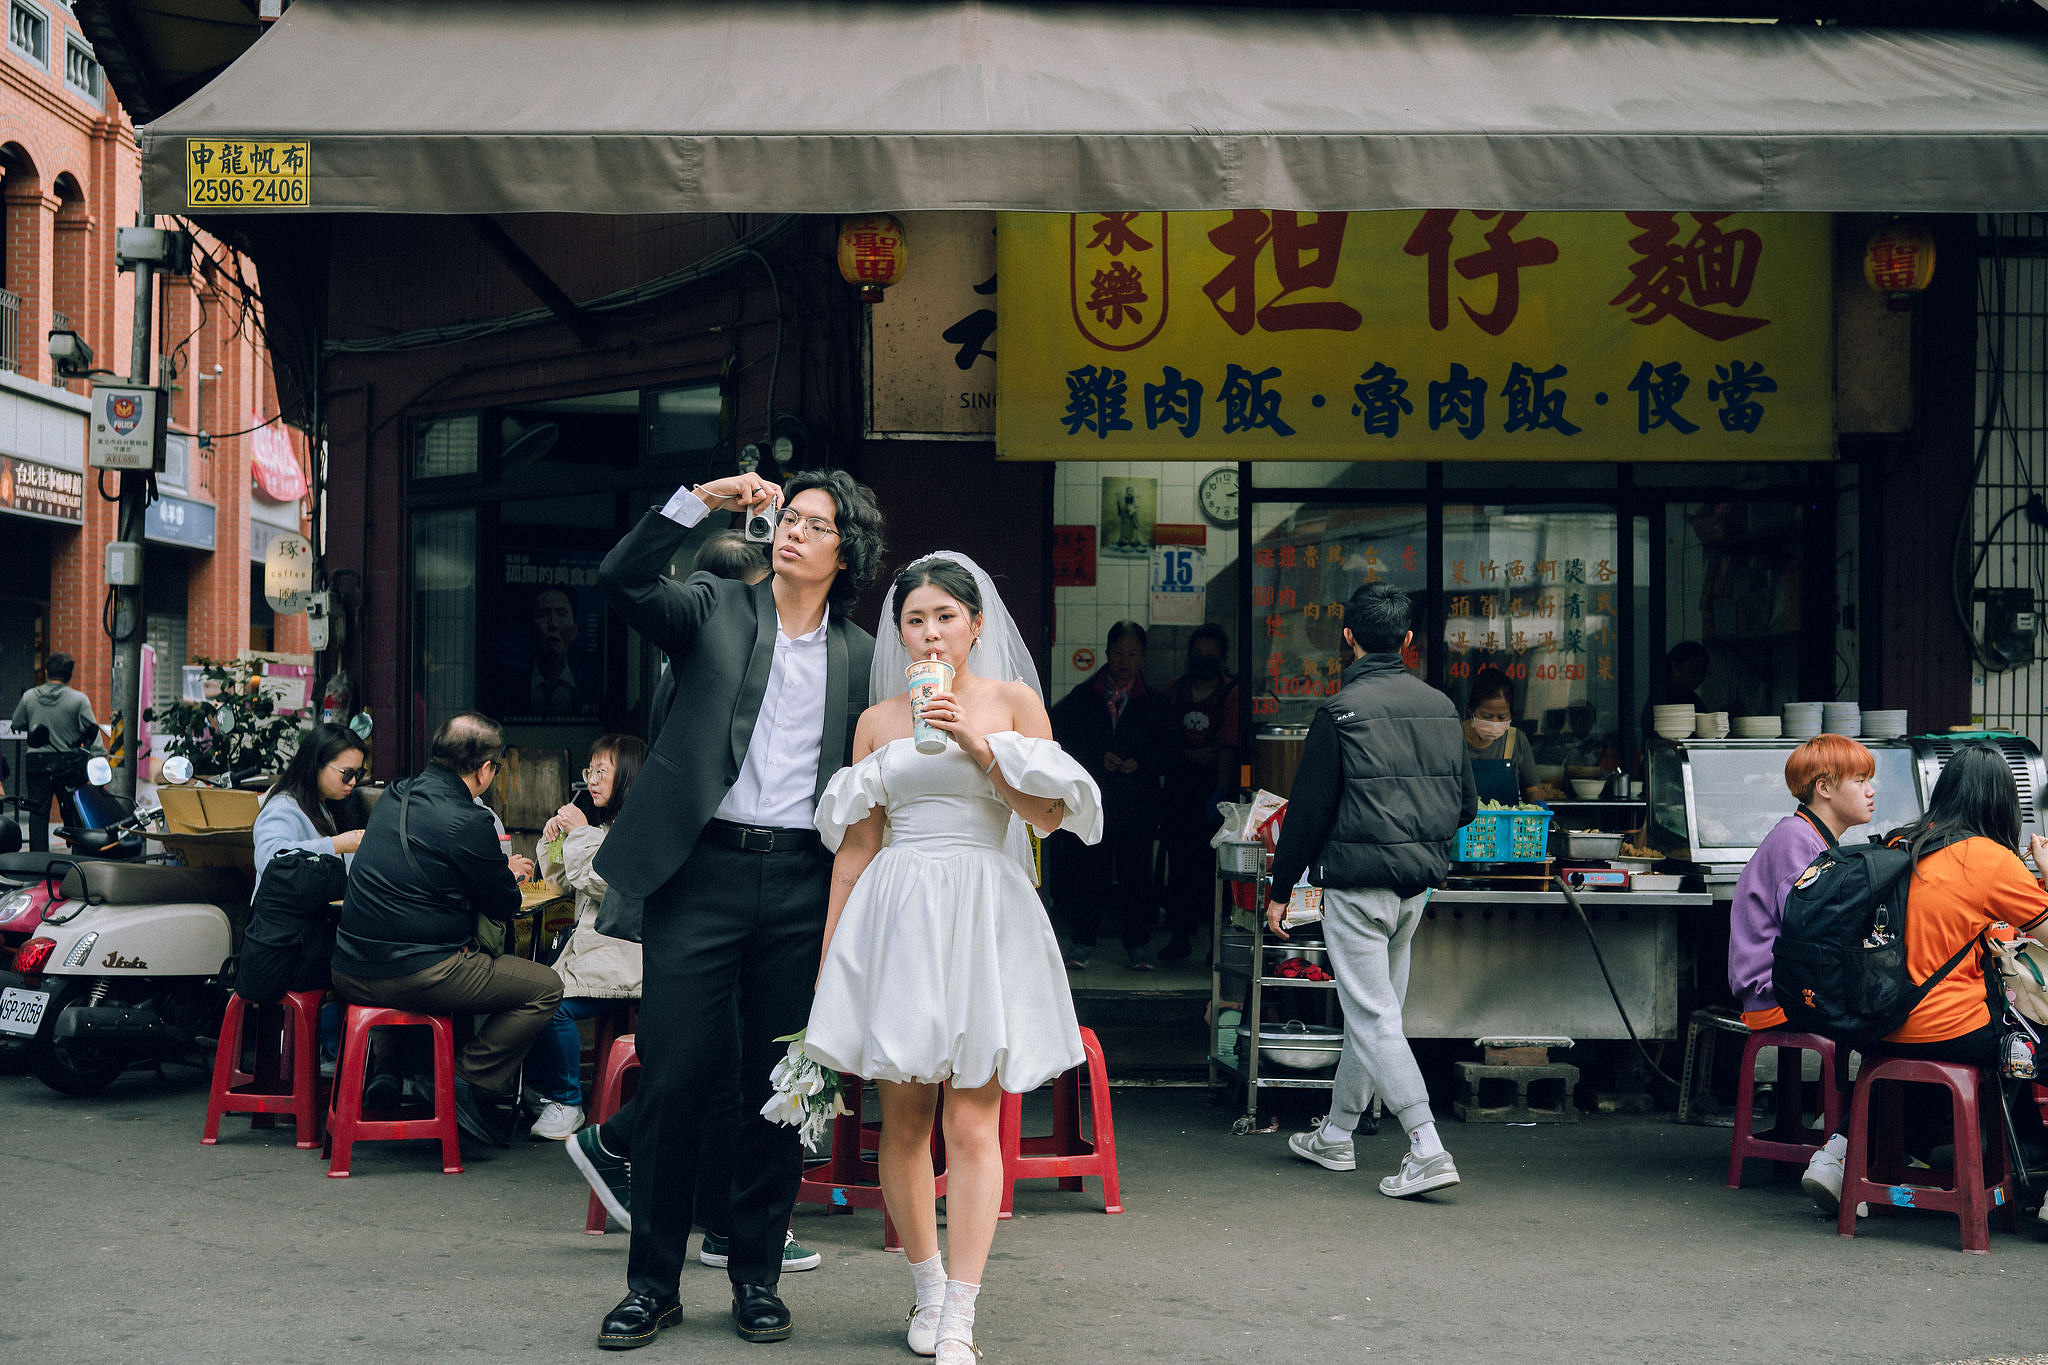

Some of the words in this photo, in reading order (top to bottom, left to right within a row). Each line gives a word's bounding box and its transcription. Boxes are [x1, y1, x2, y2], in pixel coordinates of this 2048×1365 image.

[191, 143, 305, 175] 申龍帆布
[193, 178, 303, 202] 2596-2406
[1162, 551, 1193, 585] 15
[1448, 661, 1471, 679] 40
[1505, 663, 1526, 680] 40
[1535, 663, 1557, 681] 40
[1565, 663, 1585, 681] 50
[1272, 677, 1300, 694] 120
[1302, 678, 1322, 696] 40
[1252, 696, 1279, 714] 130
